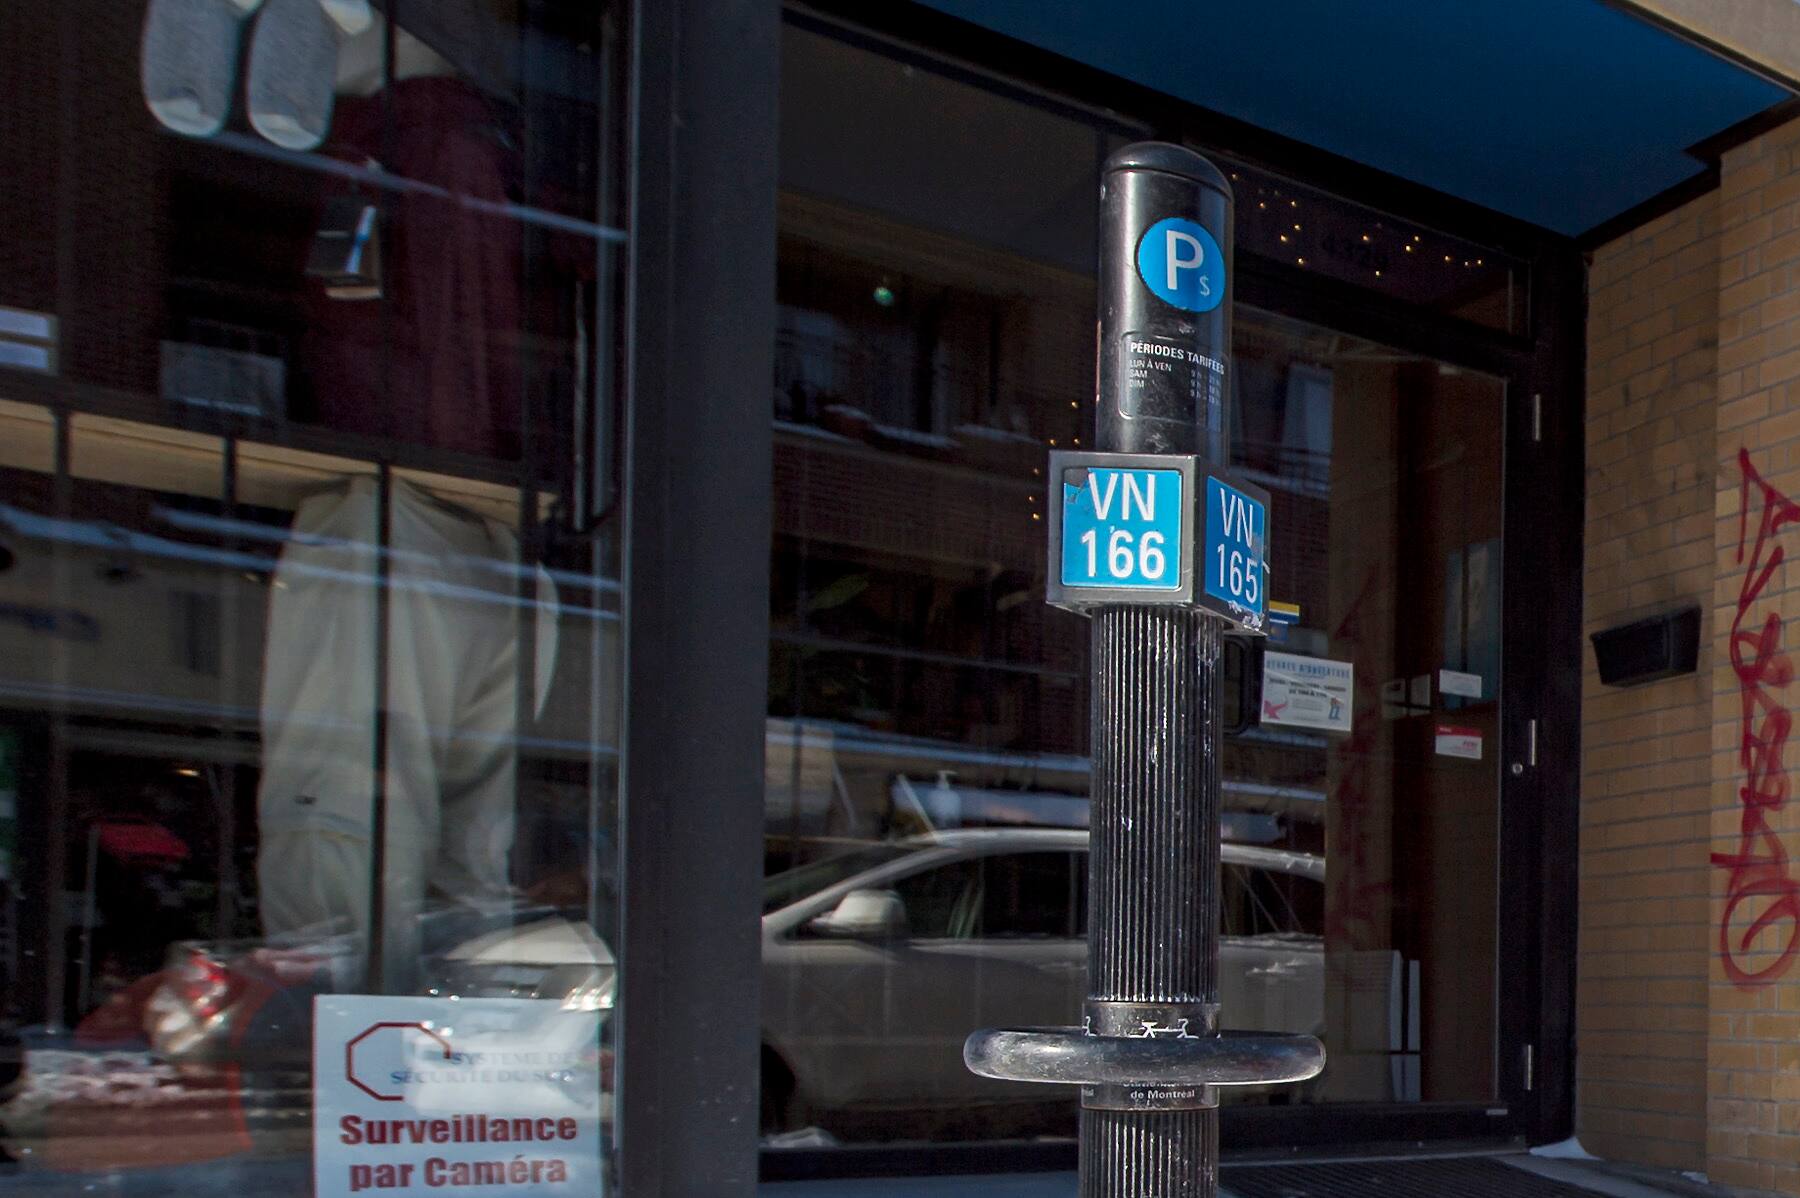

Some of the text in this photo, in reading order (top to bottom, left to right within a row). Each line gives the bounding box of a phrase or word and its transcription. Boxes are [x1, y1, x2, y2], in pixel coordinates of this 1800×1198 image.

[1166, 229, 1204, 290] P
[1130, 340, 1184, 360] PÉRIODES
[1154, 361, 1172, 372] VEN
[1129, 369, 1148, 378] SAM
[1129, 379, 1145, 388] DIM
[1088, 472, 1155, 521] VN
[1219, 487, 1254, 548] VN
[1081, 529, 1165, 579] 166
[1216, 543, 1258, 604] 165
[1130, 1090, 1144, 1099] de
[339, 1114, 578, 1145] Surveillance
[349, 1154, 567, 1192] par Caméra
